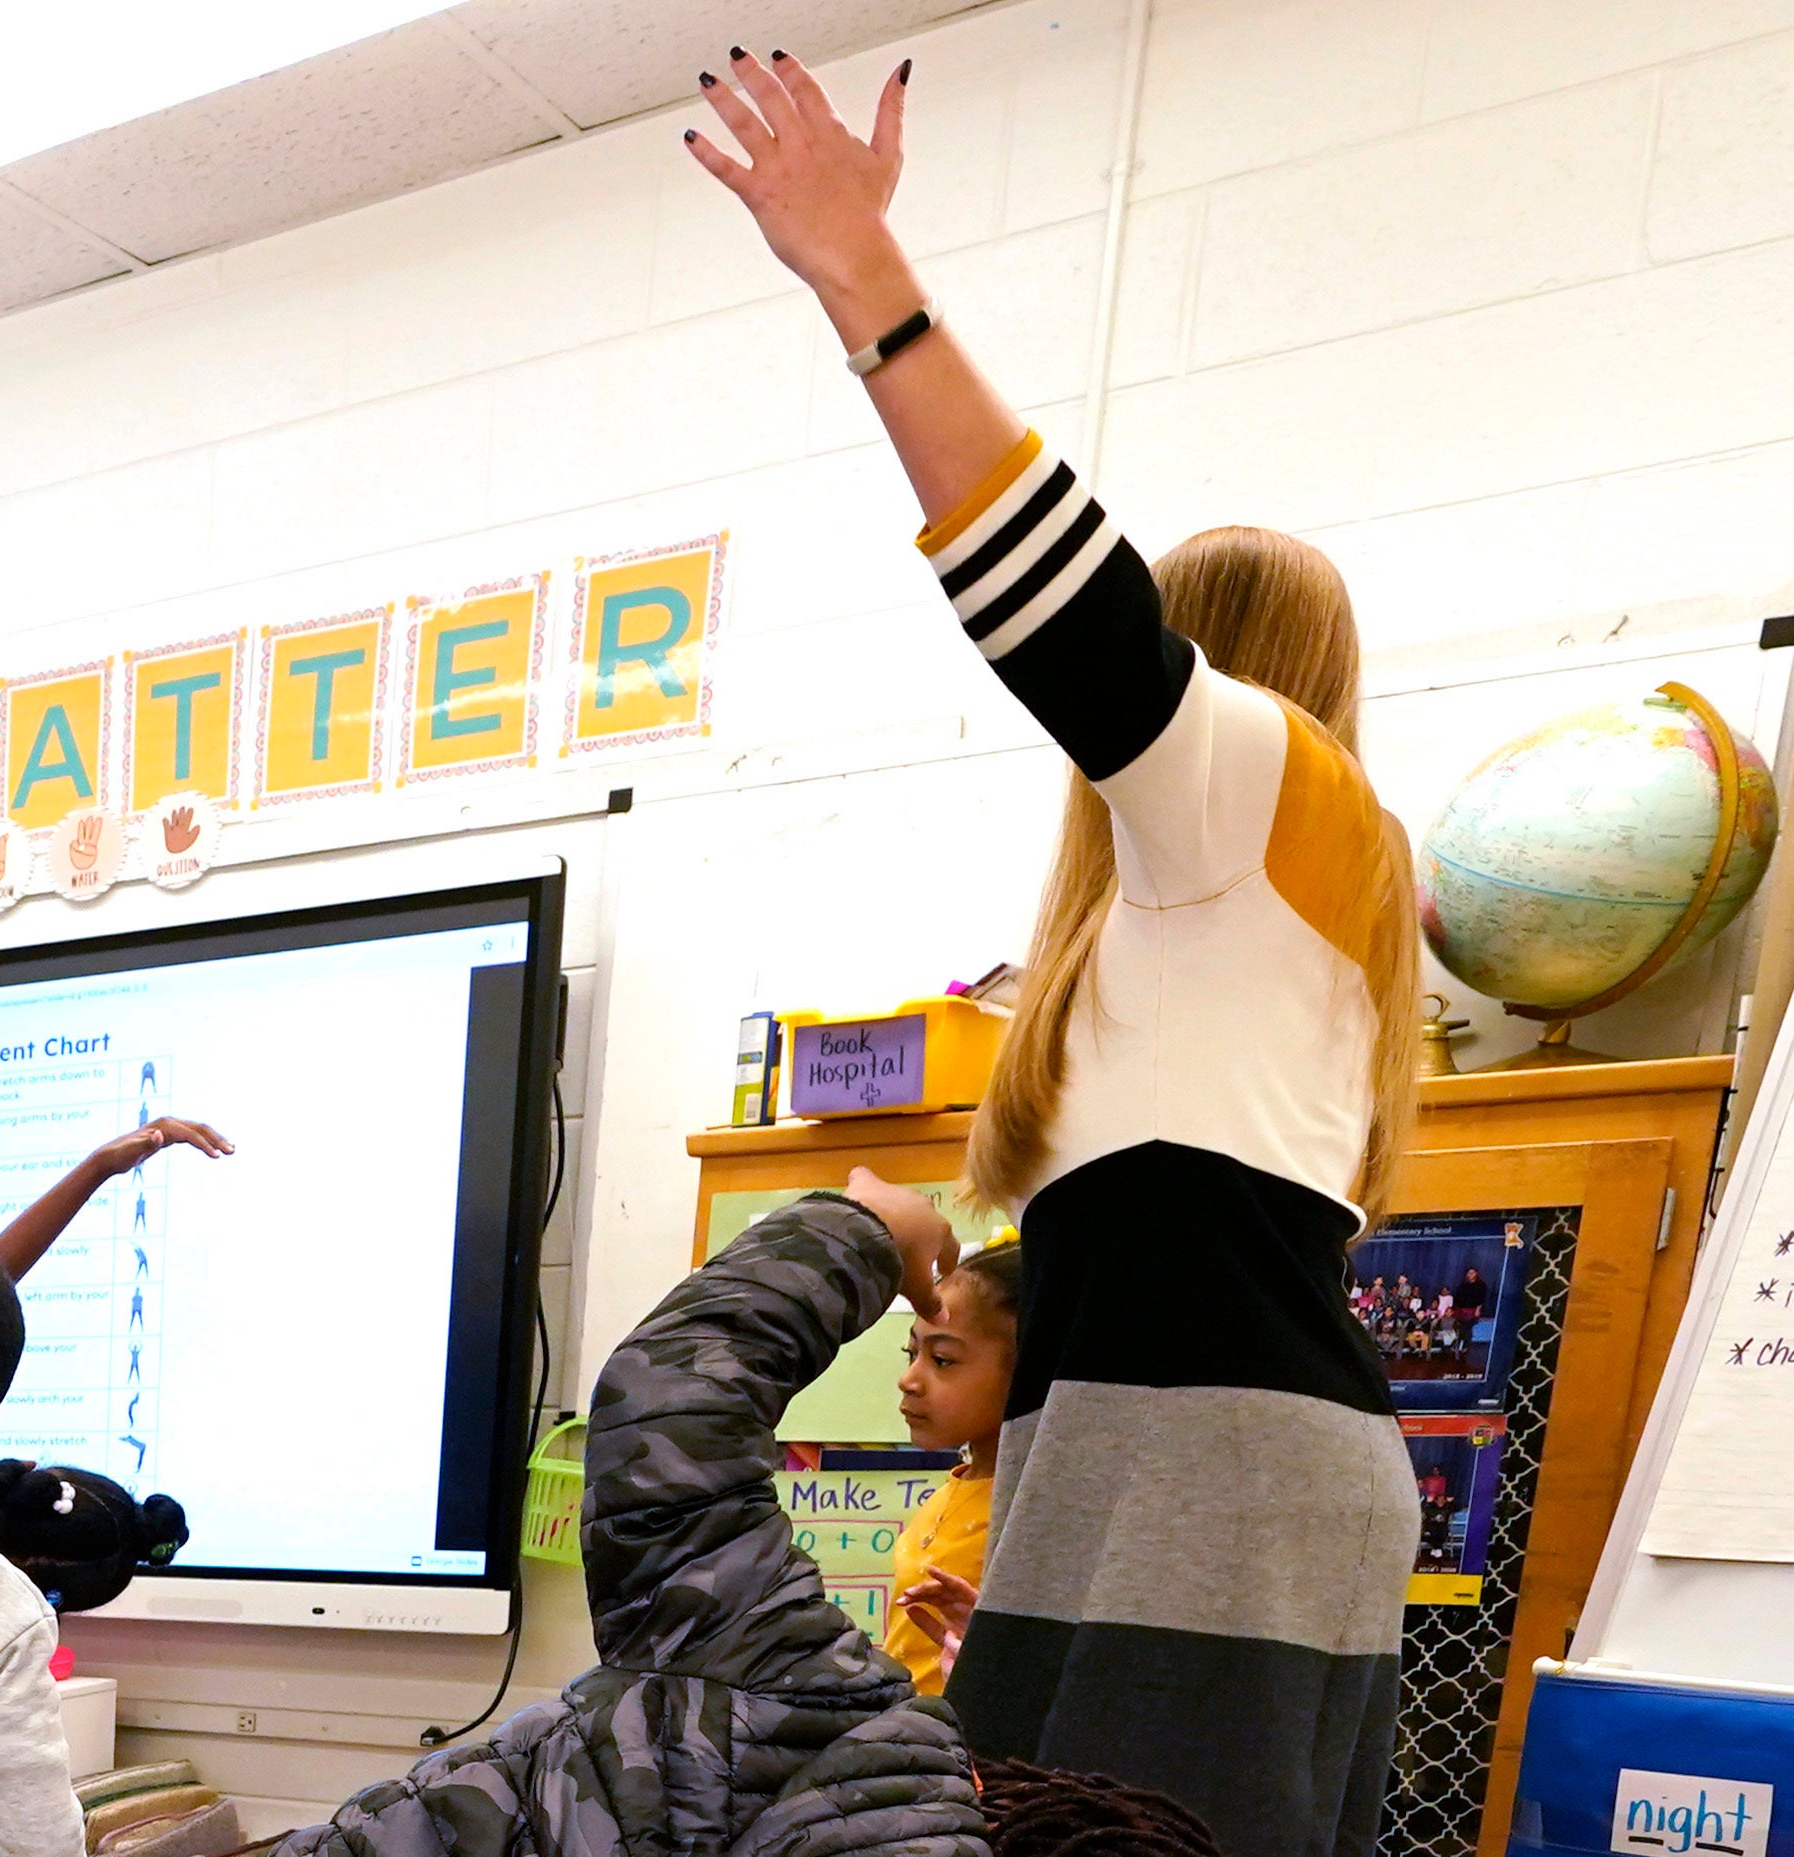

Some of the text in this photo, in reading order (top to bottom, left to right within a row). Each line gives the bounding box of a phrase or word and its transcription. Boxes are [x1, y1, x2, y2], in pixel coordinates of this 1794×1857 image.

[71, 872, 99, 888] WATER
[44, 1034, 110, 1056] Chart
[821, 1028, 872, 1056] Book
[28, 1073, 56, 1084] arms
[59, 1070, 89, 1082] down
[810, 1046, 904, 1089] Hospital
[1424, 1226, 1452, 1235] School
[792, 1477, 881, 1512] Make
[1627, 1790, 1753, 1852] night
